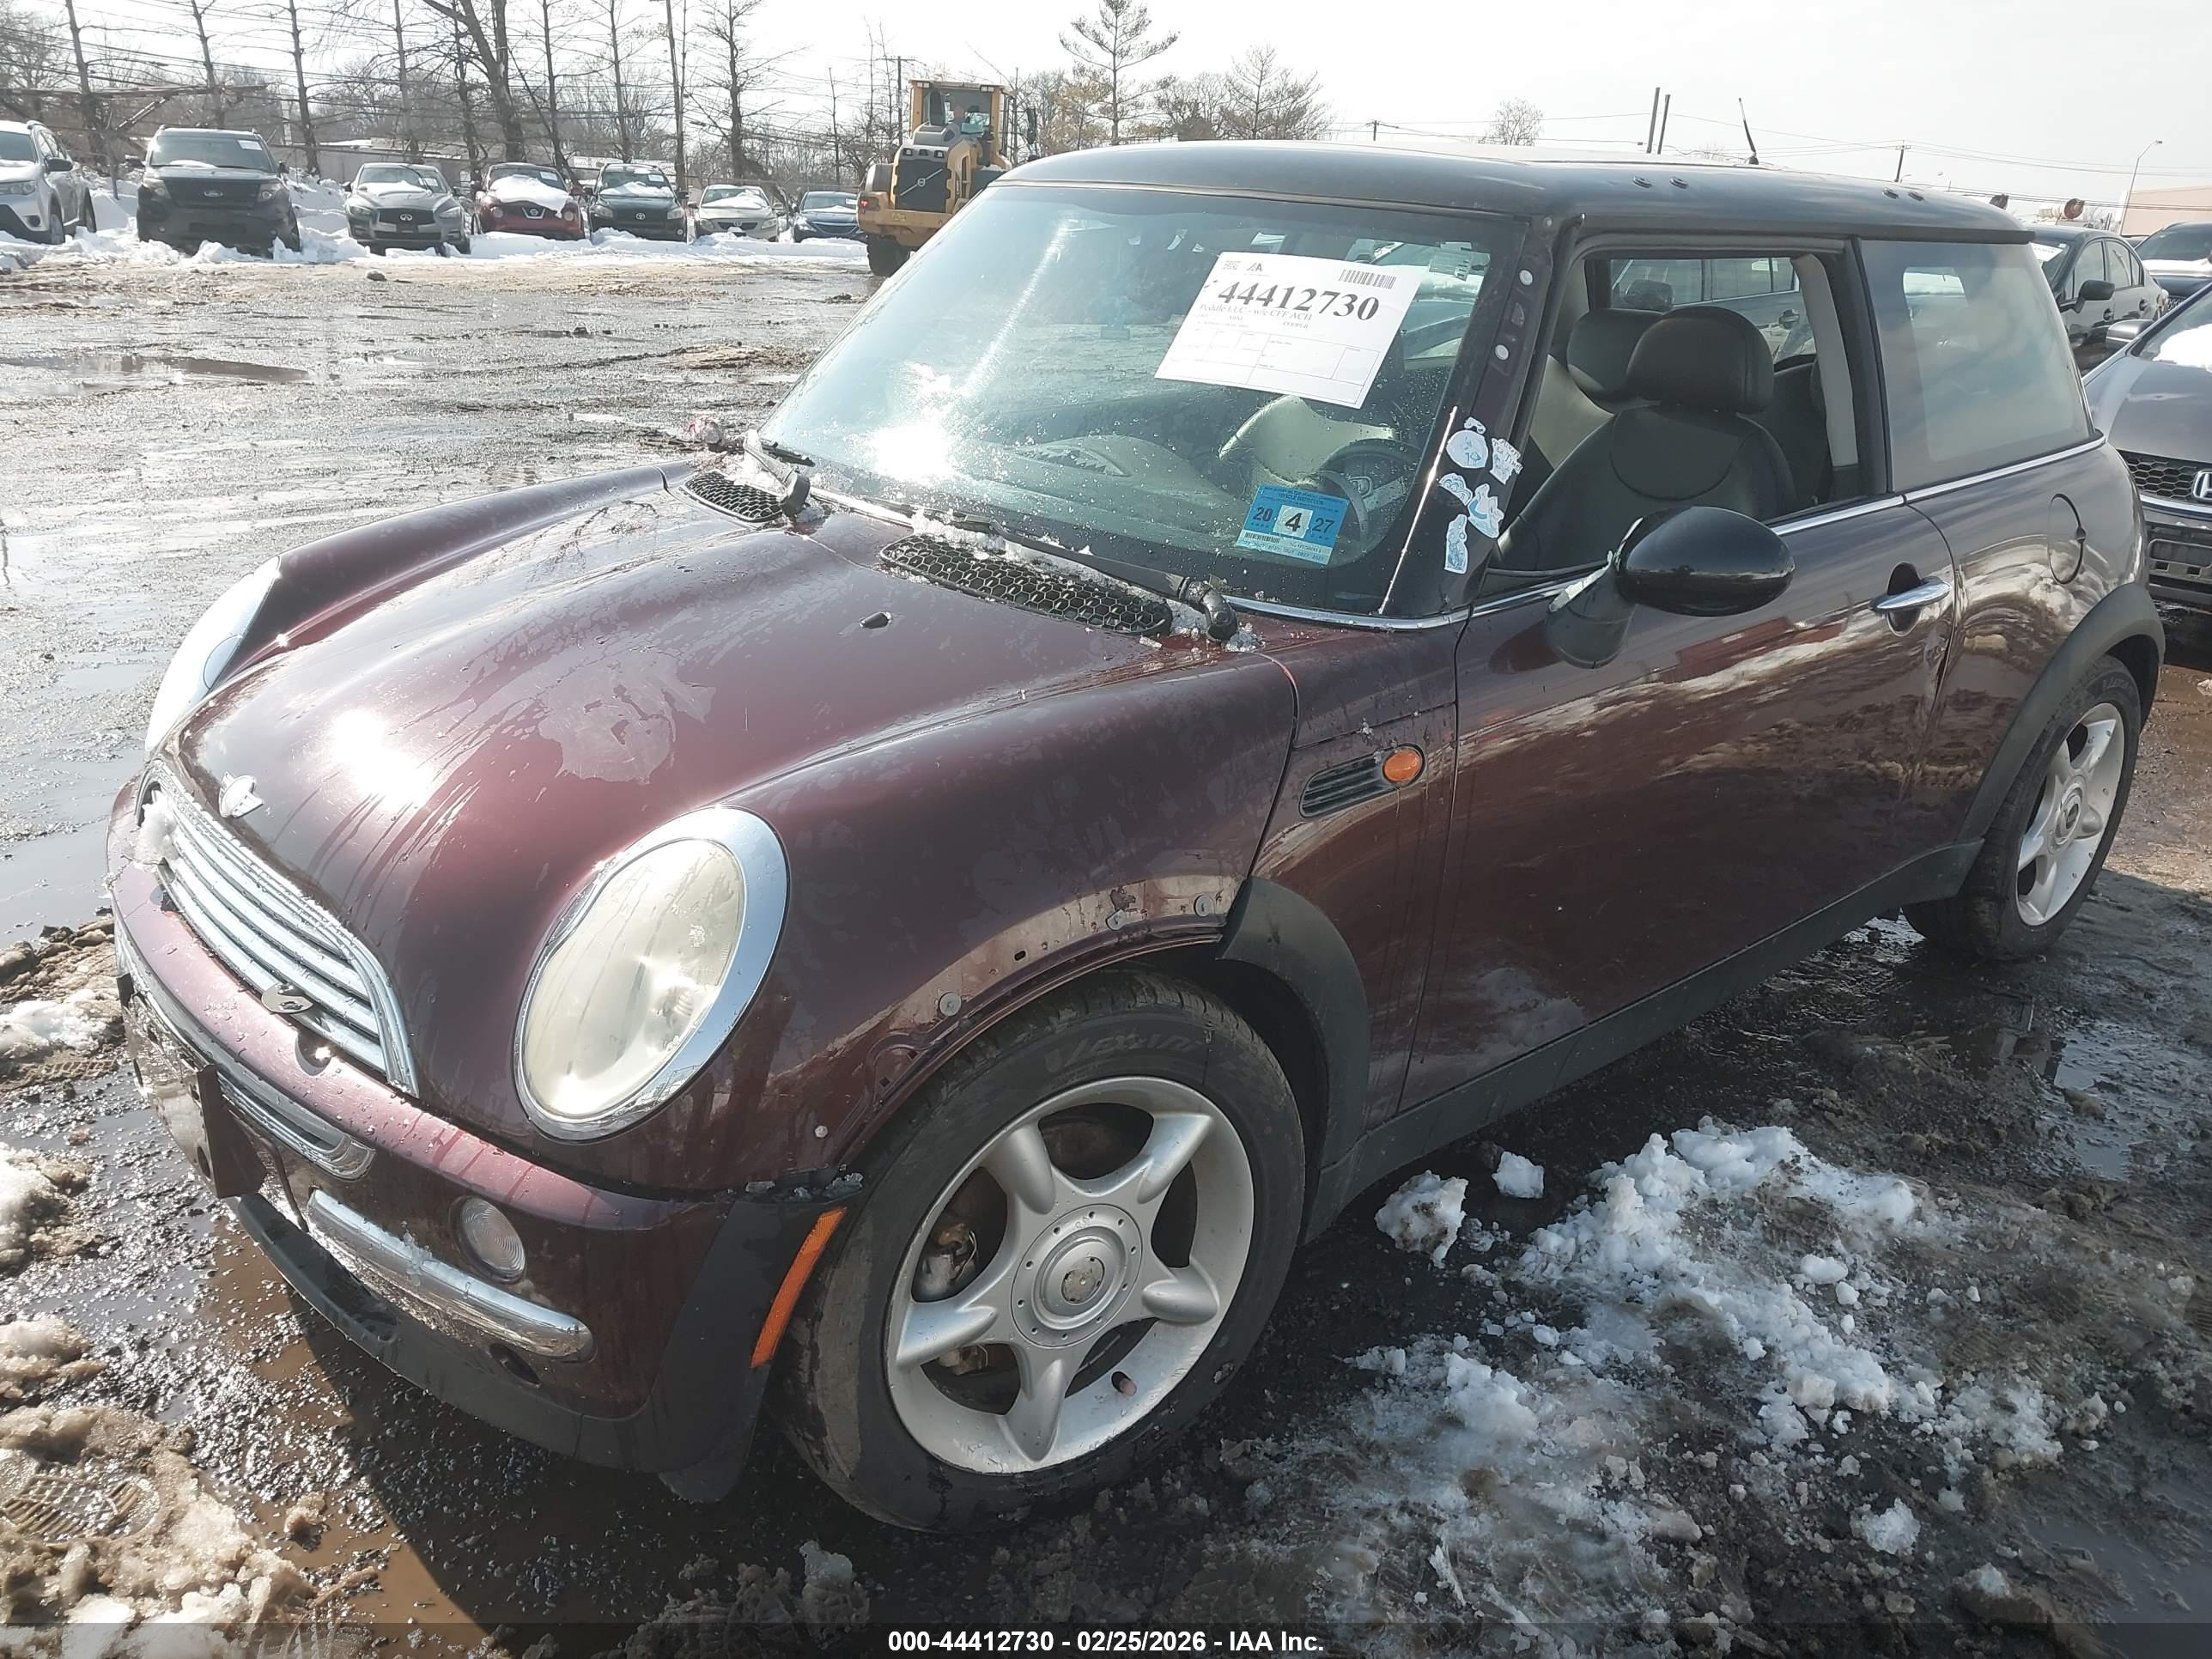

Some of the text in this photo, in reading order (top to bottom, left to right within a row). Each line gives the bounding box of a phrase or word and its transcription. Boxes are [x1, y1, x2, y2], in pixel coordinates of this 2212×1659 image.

[1218, 281, 1380, 321] 44412730
[1253, 506, 1335, 533] 20 4 27
